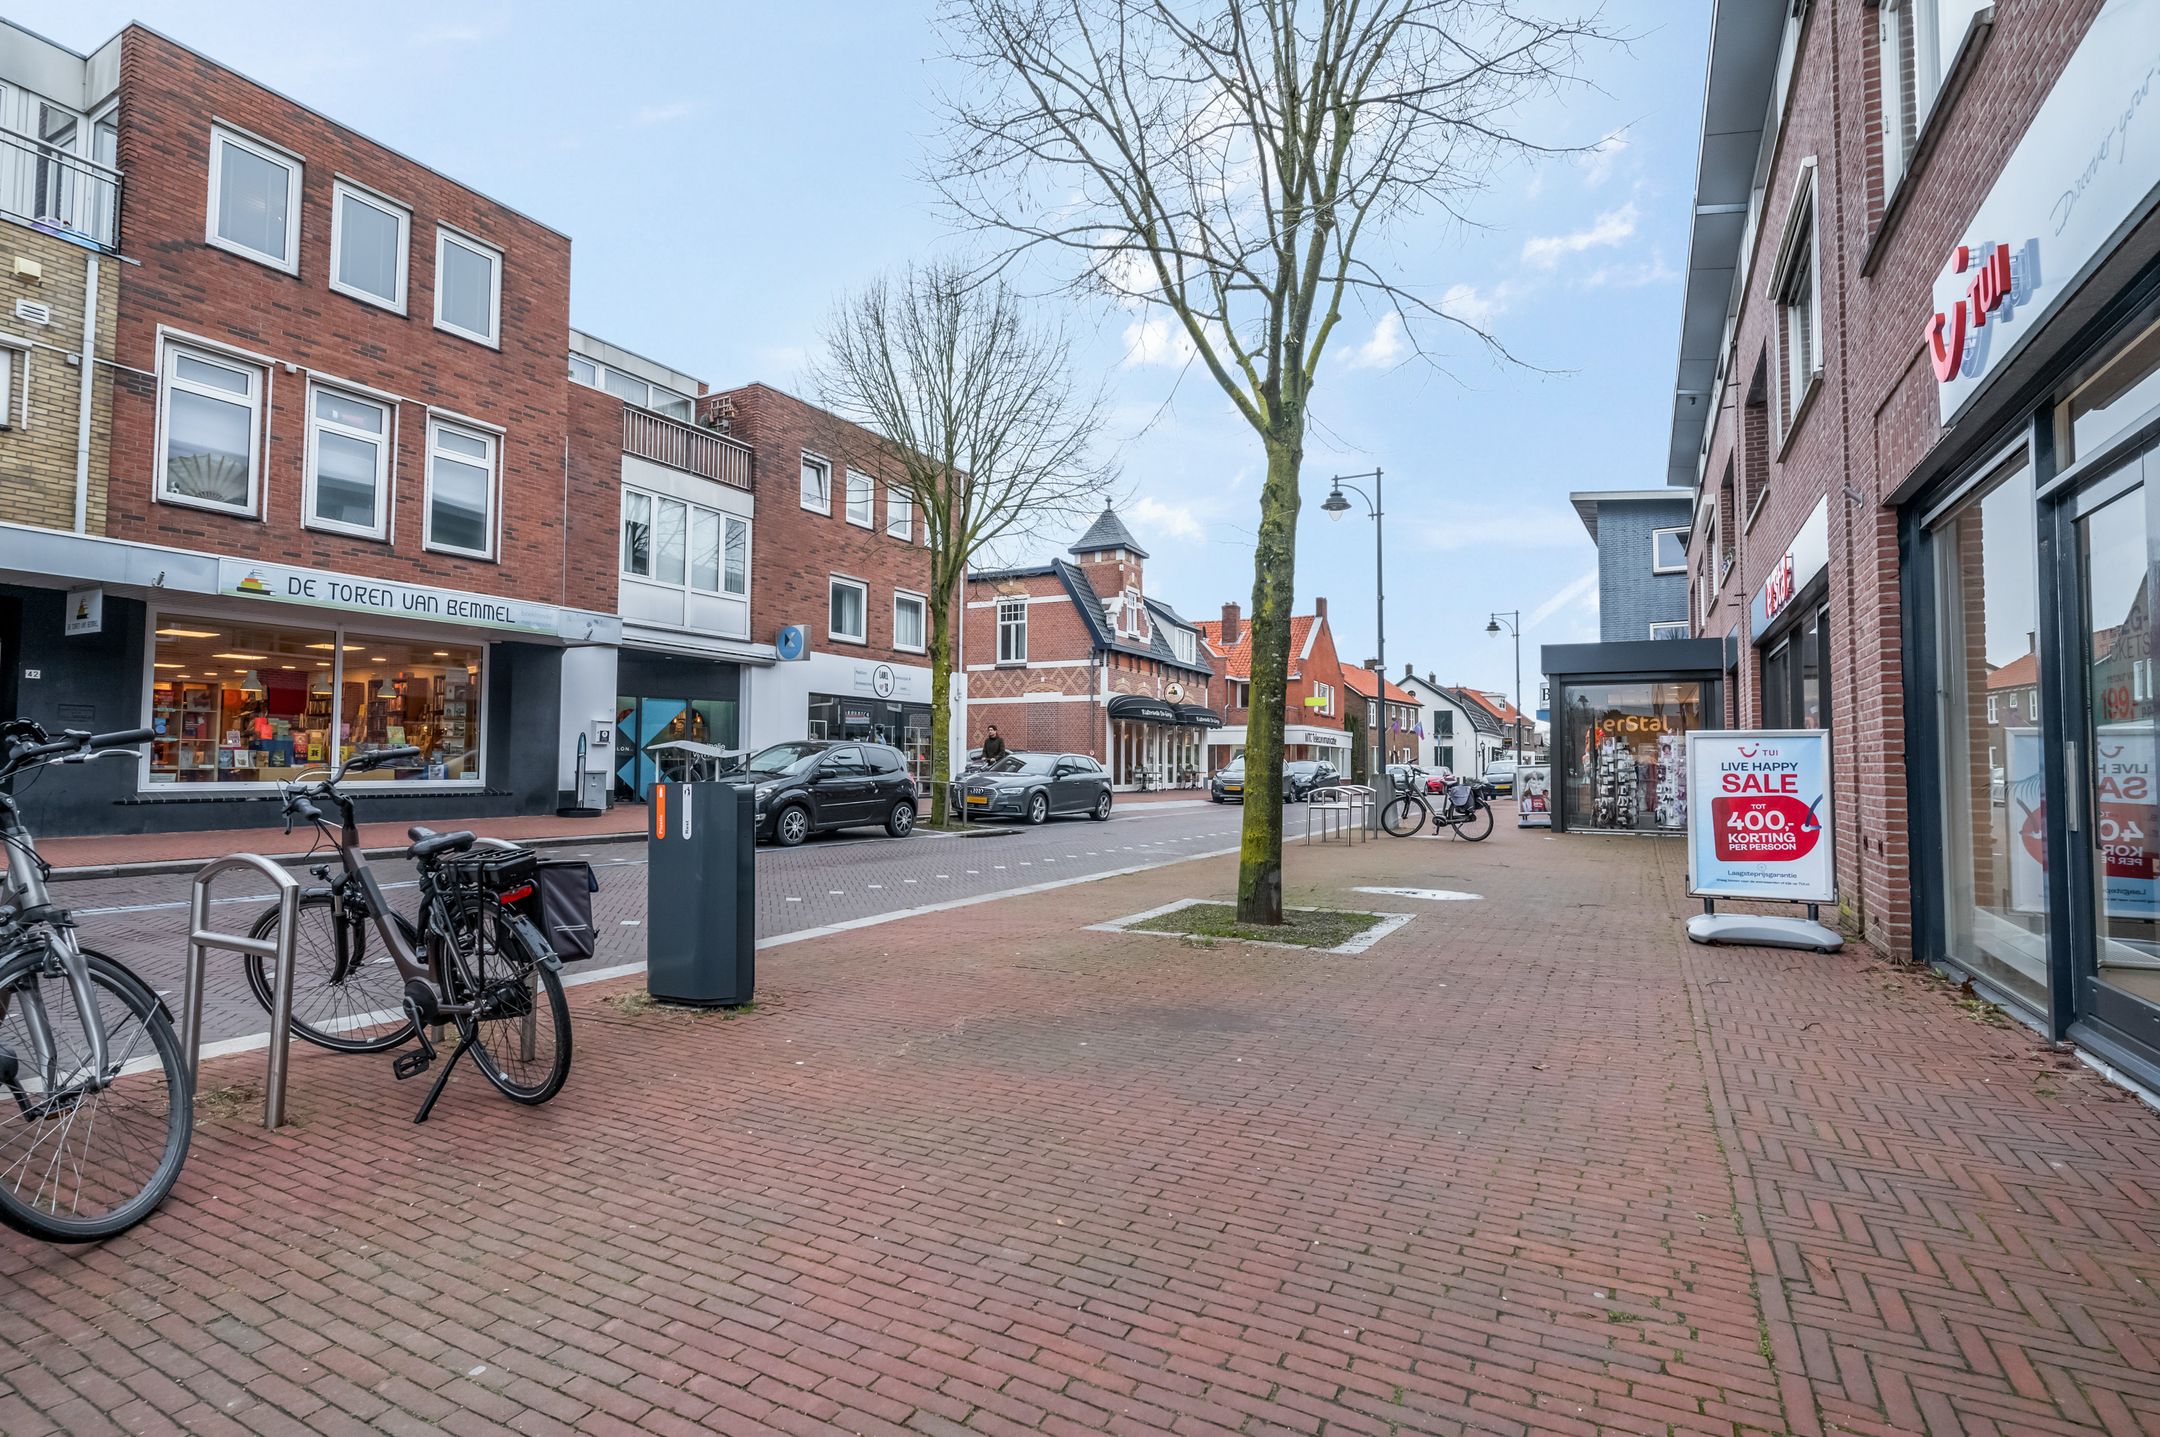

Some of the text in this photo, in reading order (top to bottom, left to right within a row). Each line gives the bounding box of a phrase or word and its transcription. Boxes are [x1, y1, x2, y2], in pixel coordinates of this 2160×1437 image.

[2049, 126, 2116, 237] Discover
[1967, 243, 2012, 329] TUI
[288, 576, 317, 598] DE
[328, 582, 393, 608] TOREN
[402, 592, 438, 613] VAN
[447, 599, 516, 624] BEMMEL
[27, 670, 39, 678] 42
[1721, 762, 1798, 771] LIVE HAPPY
[1722, 773, 1799, 793] SALE
[1727, 810, 1794, 832] 400,-
[1728, 832, 1796, 843] KORTING
[1729, 843, 1797, 851] PER PERSOON
